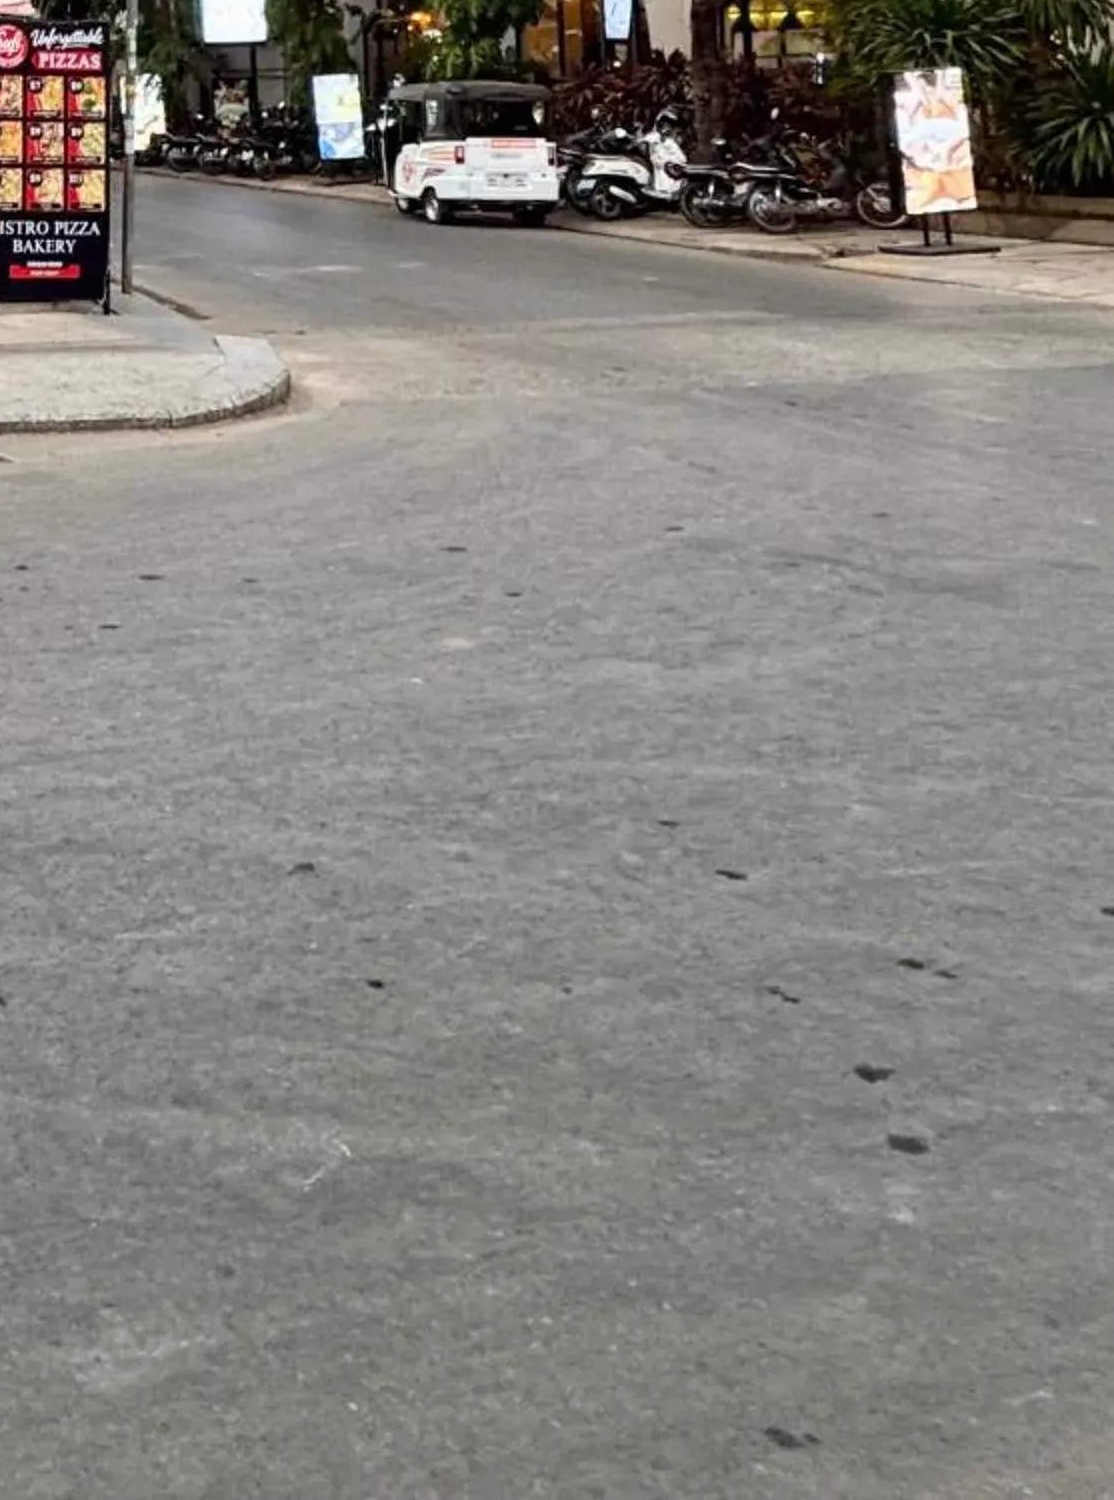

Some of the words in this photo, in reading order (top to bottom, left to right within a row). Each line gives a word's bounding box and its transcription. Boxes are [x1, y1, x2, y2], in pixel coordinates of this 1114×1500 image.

[37, 51, 103, 70] PIZZAS
[54, 220, 101, 236] PIZZA
[12, 239, 77, 254] BAKERY
